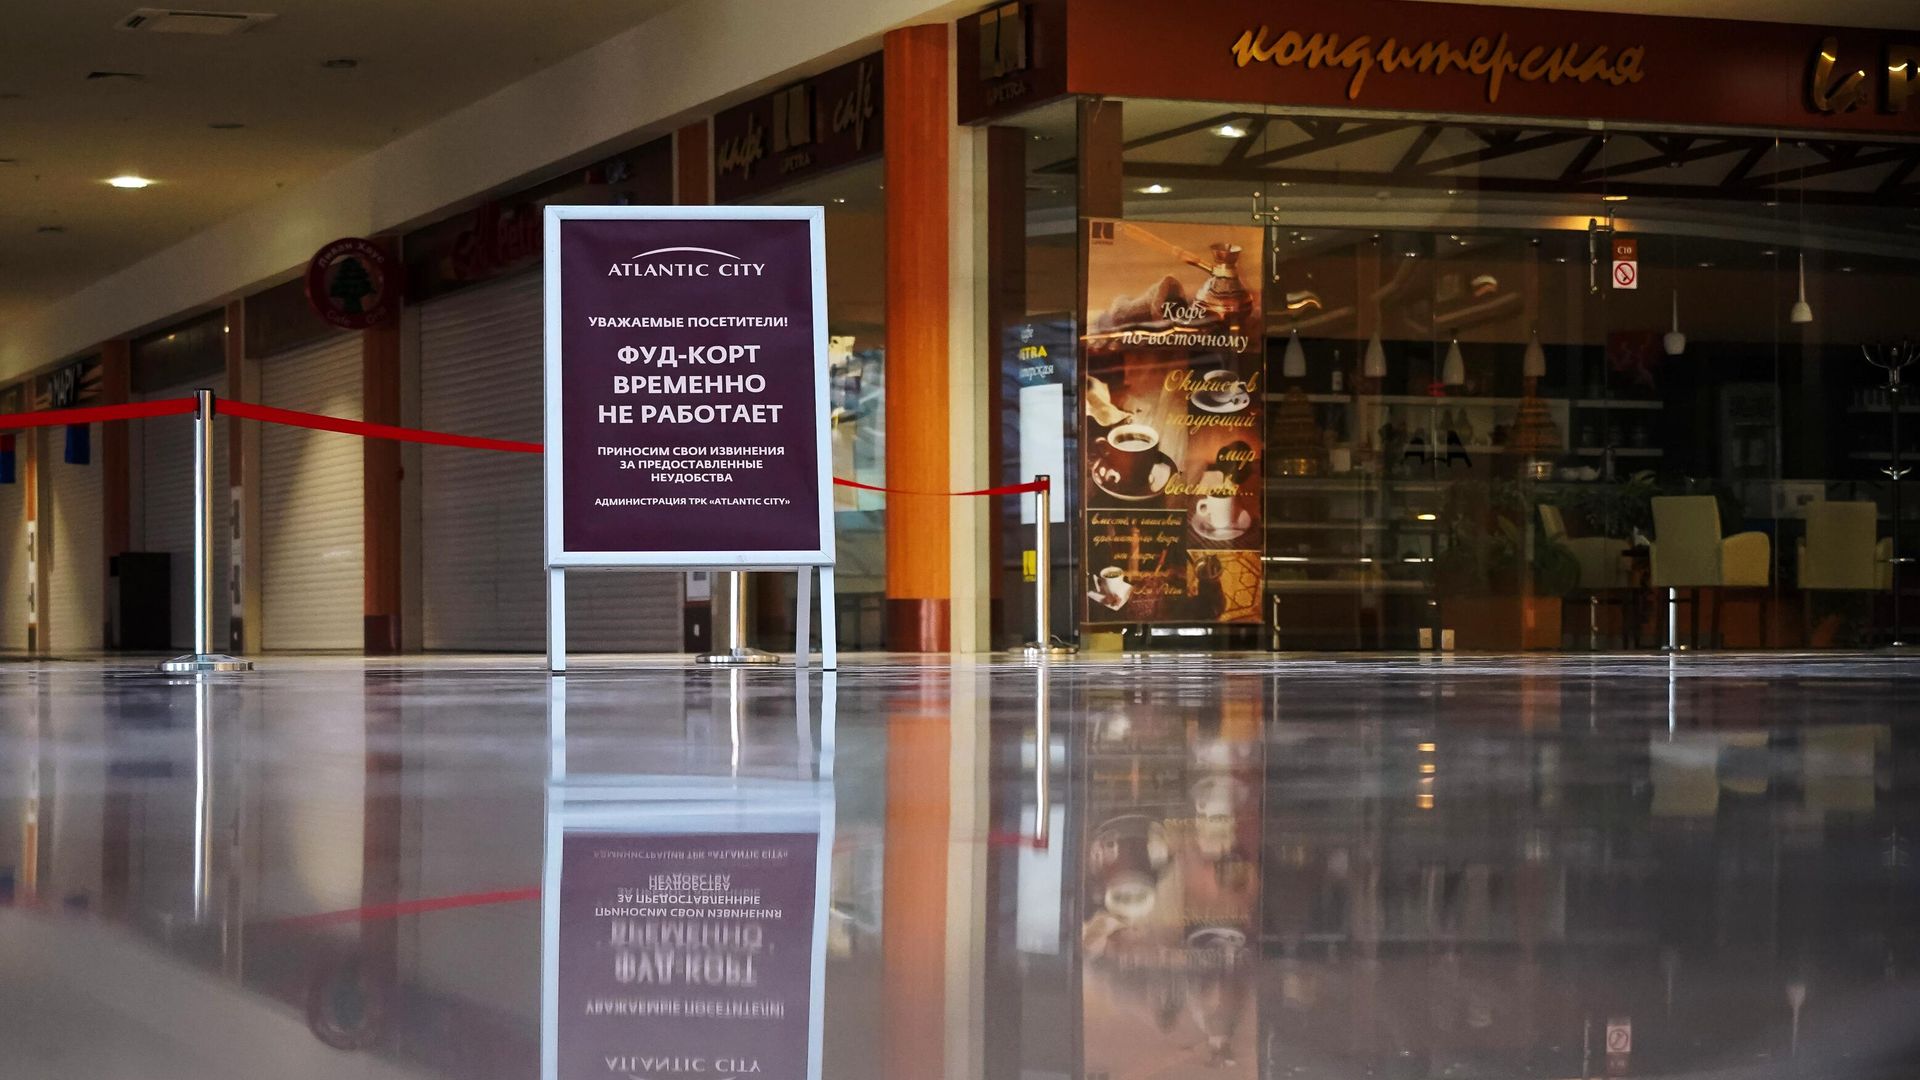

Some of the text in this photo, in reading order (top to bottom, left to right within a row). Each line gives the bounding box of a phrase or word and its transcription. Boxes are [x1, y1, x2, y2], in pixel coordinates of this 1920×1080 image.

[1231, 25, 1645, 103] кондитерская
[1617, 246, 1632, 254] C10
[609, 264, 764, 276] ATLANTIC CITY
[1161, 301, 1207, 324] Кофе
[589, 317, 787, 327] УВАЖАЕМЫЕ ПОСЕТИТЕЛИ!
[1121, 332, 1249, 353] по-восточному
[618, 345, 760, 367] ФУД-КОРТ
[614, 375, 765, 393] ВРЕМЕННО
[599, 405, 783, 423] НЕ РАБОТАЕТ
[598, 447, 784, 455] ПРИНОСИМ СВОИ ИЗВИНЕНИЯ
[620, 460, 763, 470] ЗА ПРЕДОСТАВЛЕННЫЕ
[1218, 450, 1256, 470] мир
[652, 474, 733, 483] НЕУДОБСТВА
[595, 498, 686, 506] АДМИНИСТРАЦИЯ
